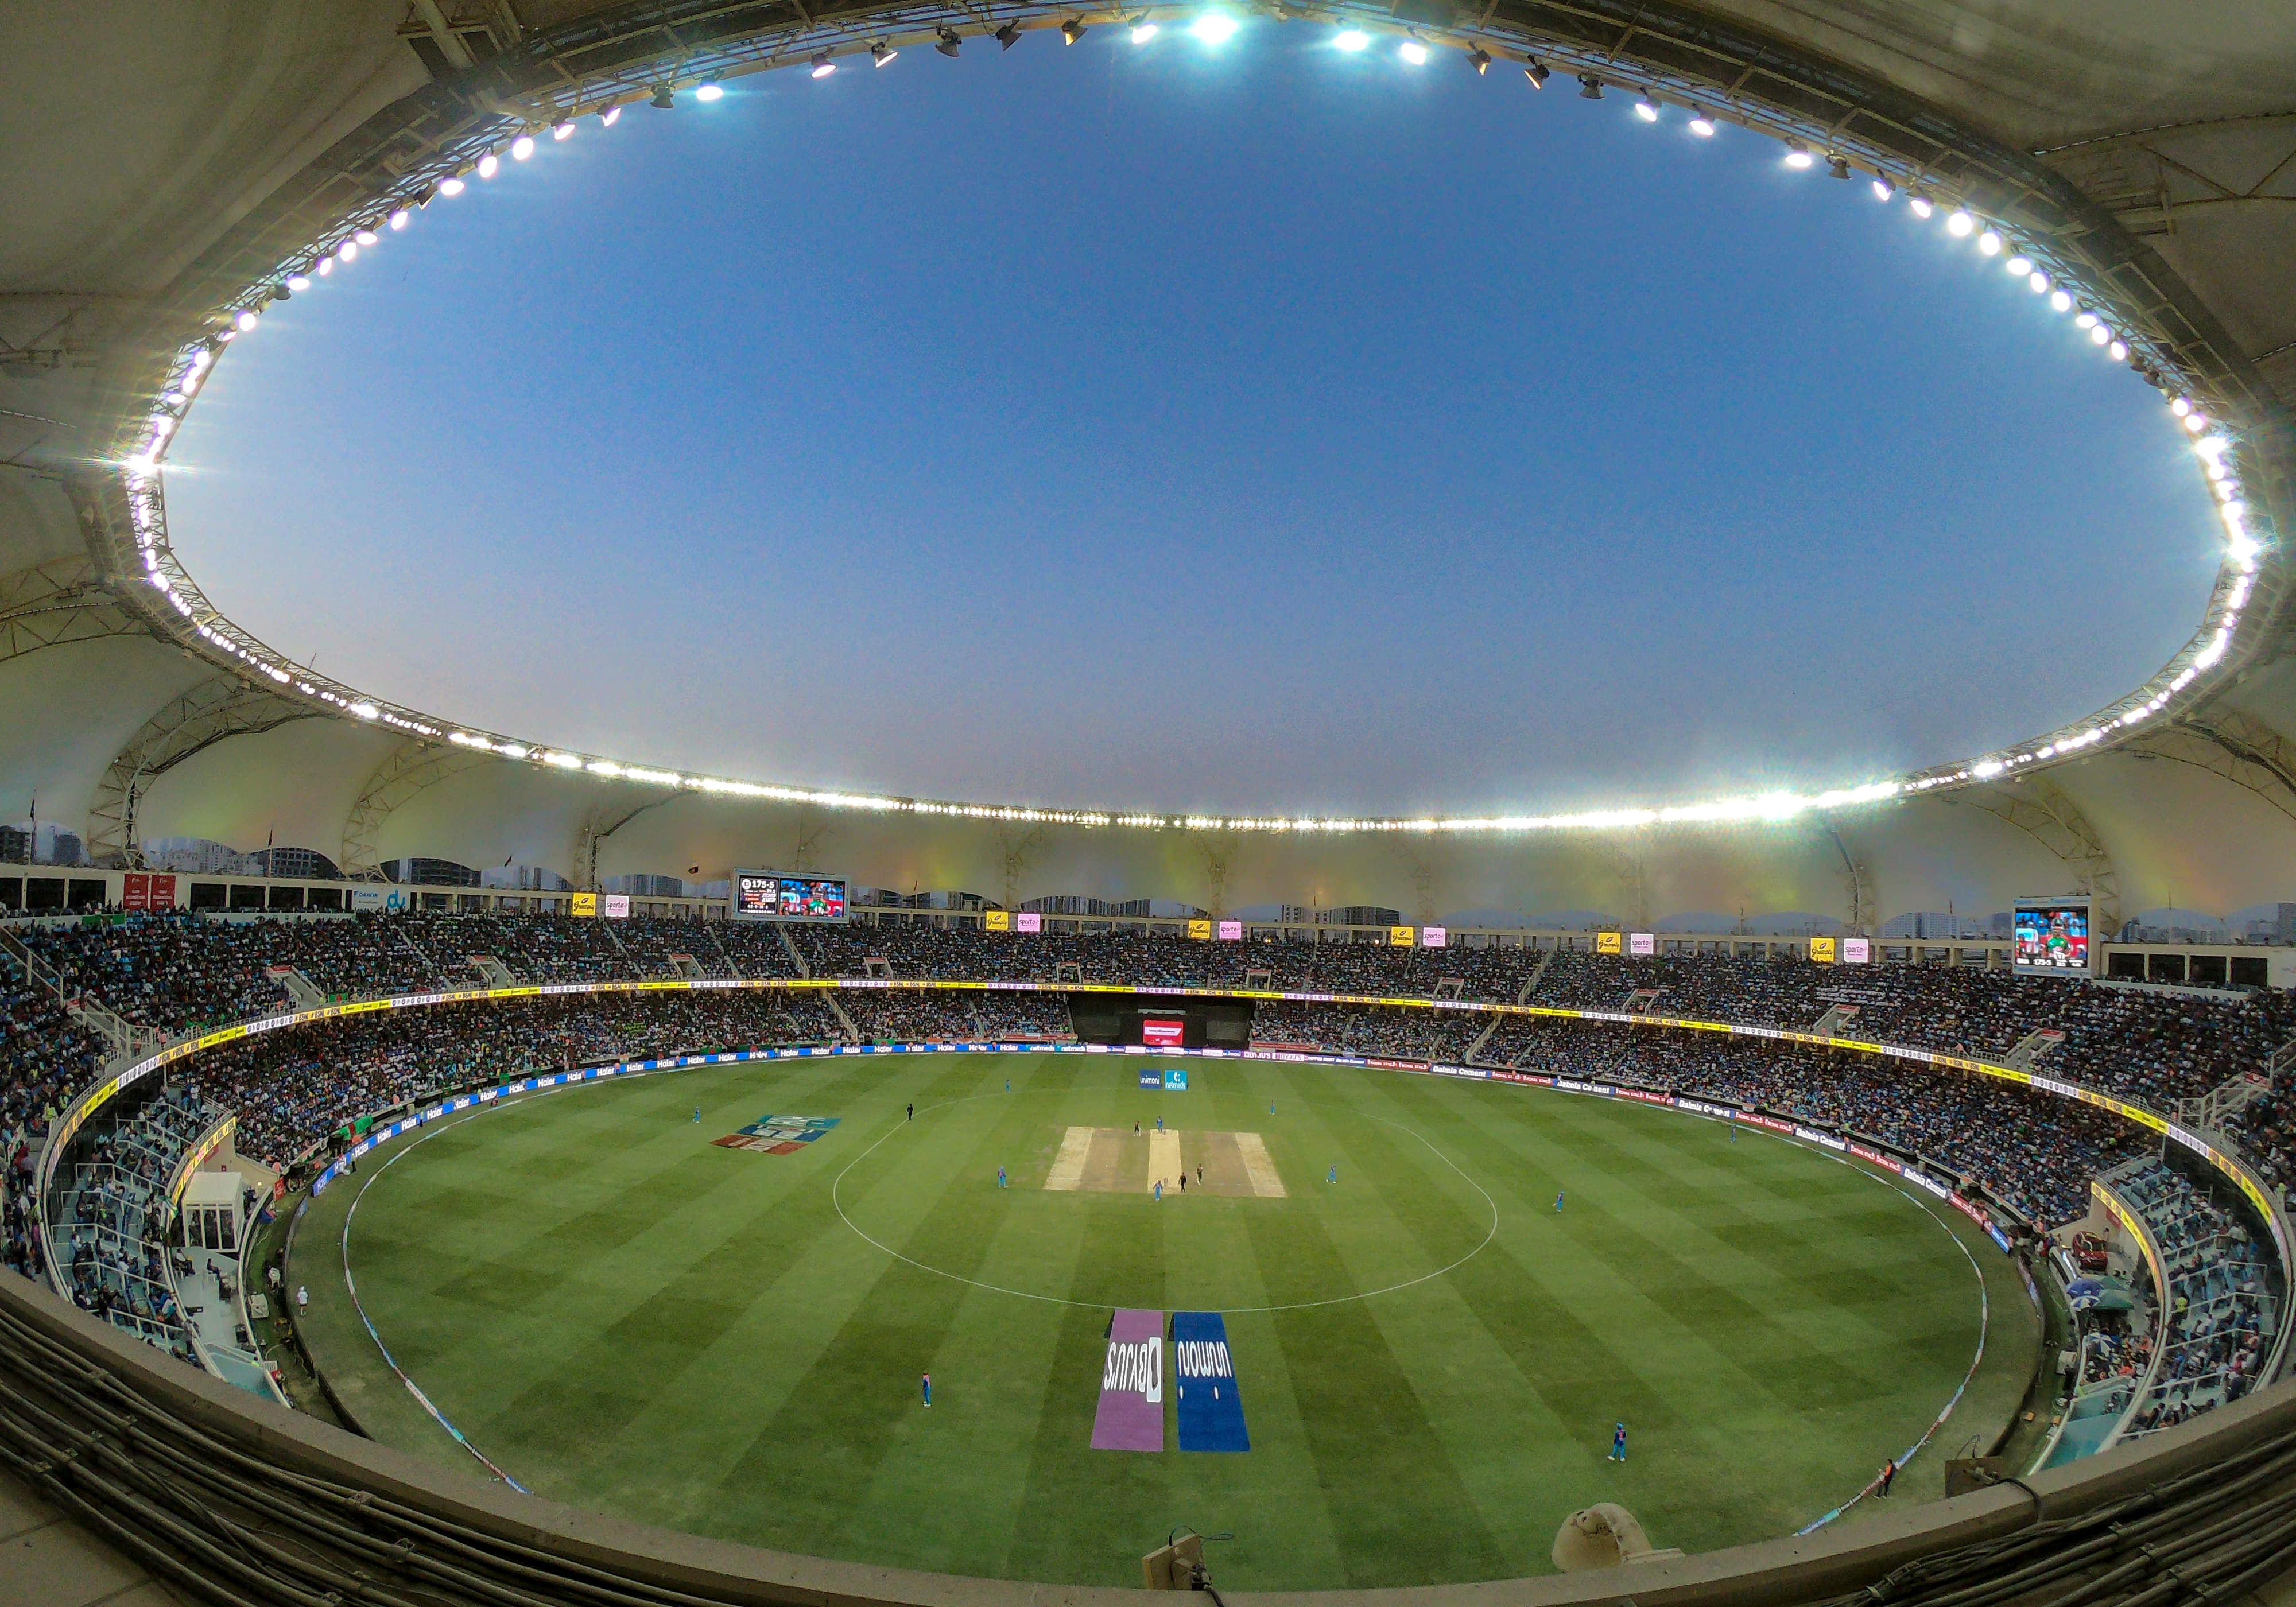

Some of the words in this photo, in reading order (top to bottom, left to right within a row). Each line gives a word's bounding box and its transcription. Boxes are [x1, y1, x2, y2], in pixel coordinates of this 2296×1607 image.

[752, 880, 774, 888] 175-5
[812, 1047, 830, 1055] Haier
[843, 1046, 861, 1054] Haier
[937, 1043, 956, 1051] Haier
[1000, 1043, 1019, 1051] Haier
[719, 1052, 737, 1062] Haier
[780, 1049, 798, 1057] Haier
[657, 1058, 674, 1069] Haier
[687, 1055, 705, 1065] Haier
[597, 1066, 615, 1077] Haier
[627, 1062, 644, 1073] Haier
[1433, 1065, 1457, 1074] Dalmia
[1459, 1068, 1487, 1077] Cement
[567, 1071, 581, 1081] Haie
[1140, 1074, 1160, 1084] unimoni
[538, 1077, 555, 1088] Haier
[1165, 1081, 1186, 1090] netmeds
[480, 1090, 497, 1101] Haier
[1679, 1100, 1702, 1111] Dalmia
[427, 1106, 443, 1120] Haier
[402, 1117, 417, 1131] Haier
[377, 1128, 392, 1143] Haier
[1797, 1128, 1820, 1142] Dalmia
[1820, 1135, 1845, 1151] Cement
[355, 1142, 369, 1158] Haier
[1104, 1341, 1147, 1393] BYJU'S
[1178, 1340, 1232, 1400] unimoni
